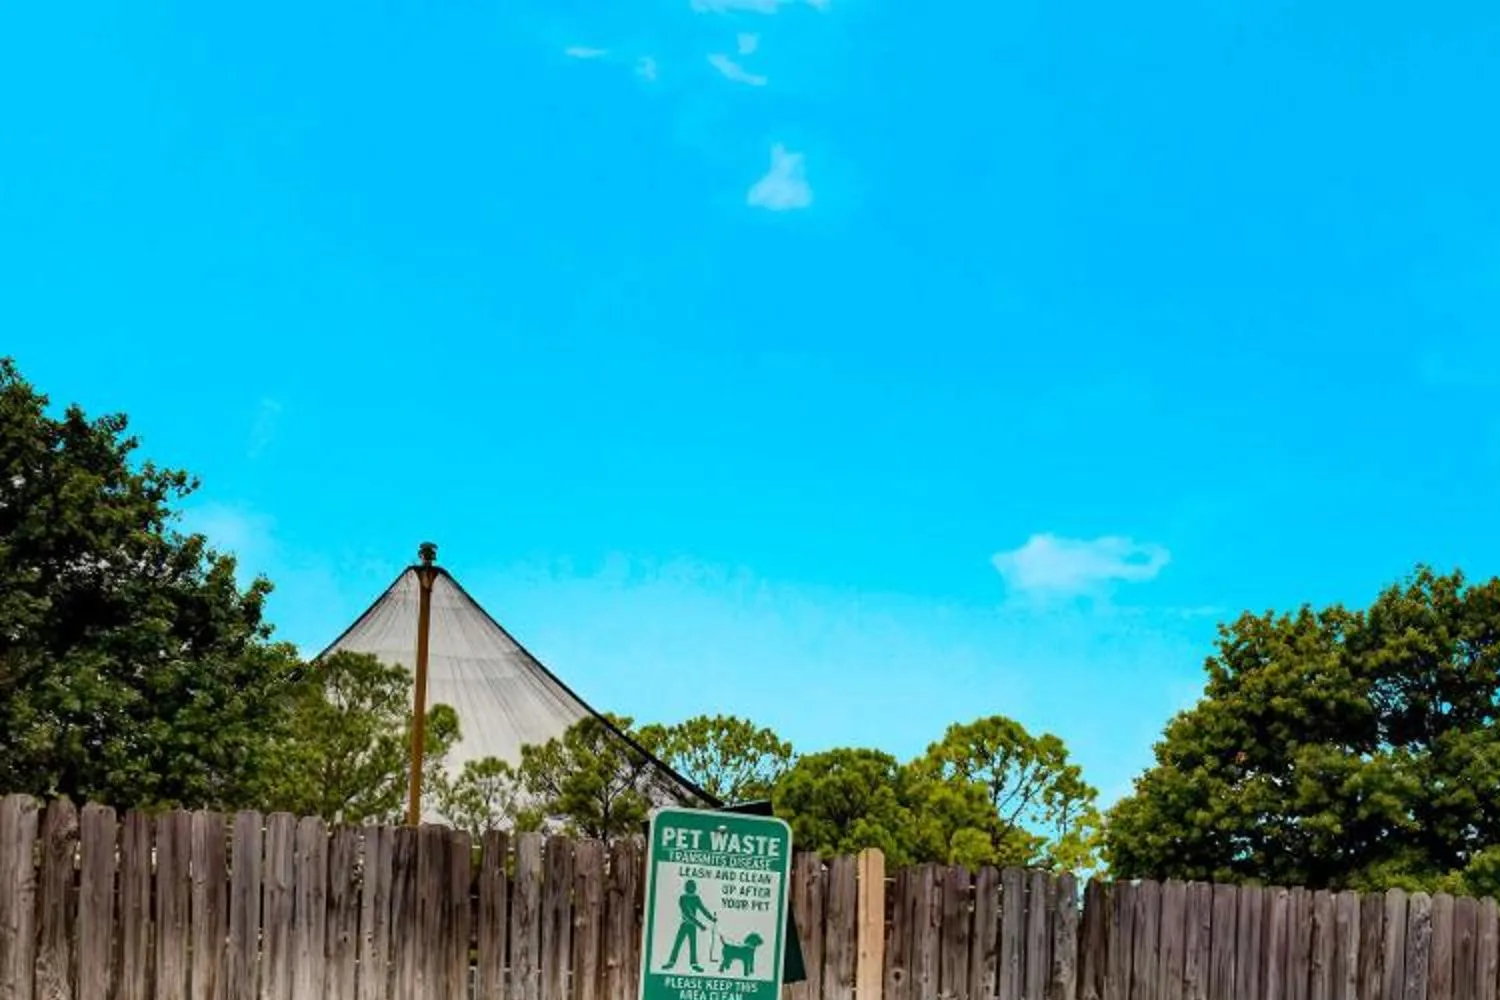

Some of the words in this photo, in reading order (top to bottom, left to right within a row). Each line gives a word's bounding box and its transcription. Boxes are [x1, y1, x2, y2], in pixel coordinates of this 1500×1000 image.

[662, 827, 702, 849] PET
[710, 831, 781, 857] WASTE
[669, 850, 728, 867] TRANSMITS
[729, 855, 770, 870] DISEASE
[680, 866, 712, 879] LEASH
[715, 869, 737, 881] AND
[740, 871, 771, 883] CLEAN
[721, 884, 736, 895] UP
[740, 885, 771, 897] AFTER
[721, 898, 749, 909] YOUR
[751, 900, 769, 911] PET
[665, 976, 702, 989] PLEASE
[706, 979, 733, 991] KEEP
[735, 981, 759, 993] THIS
[680, 989, 706, 1000] AREA
